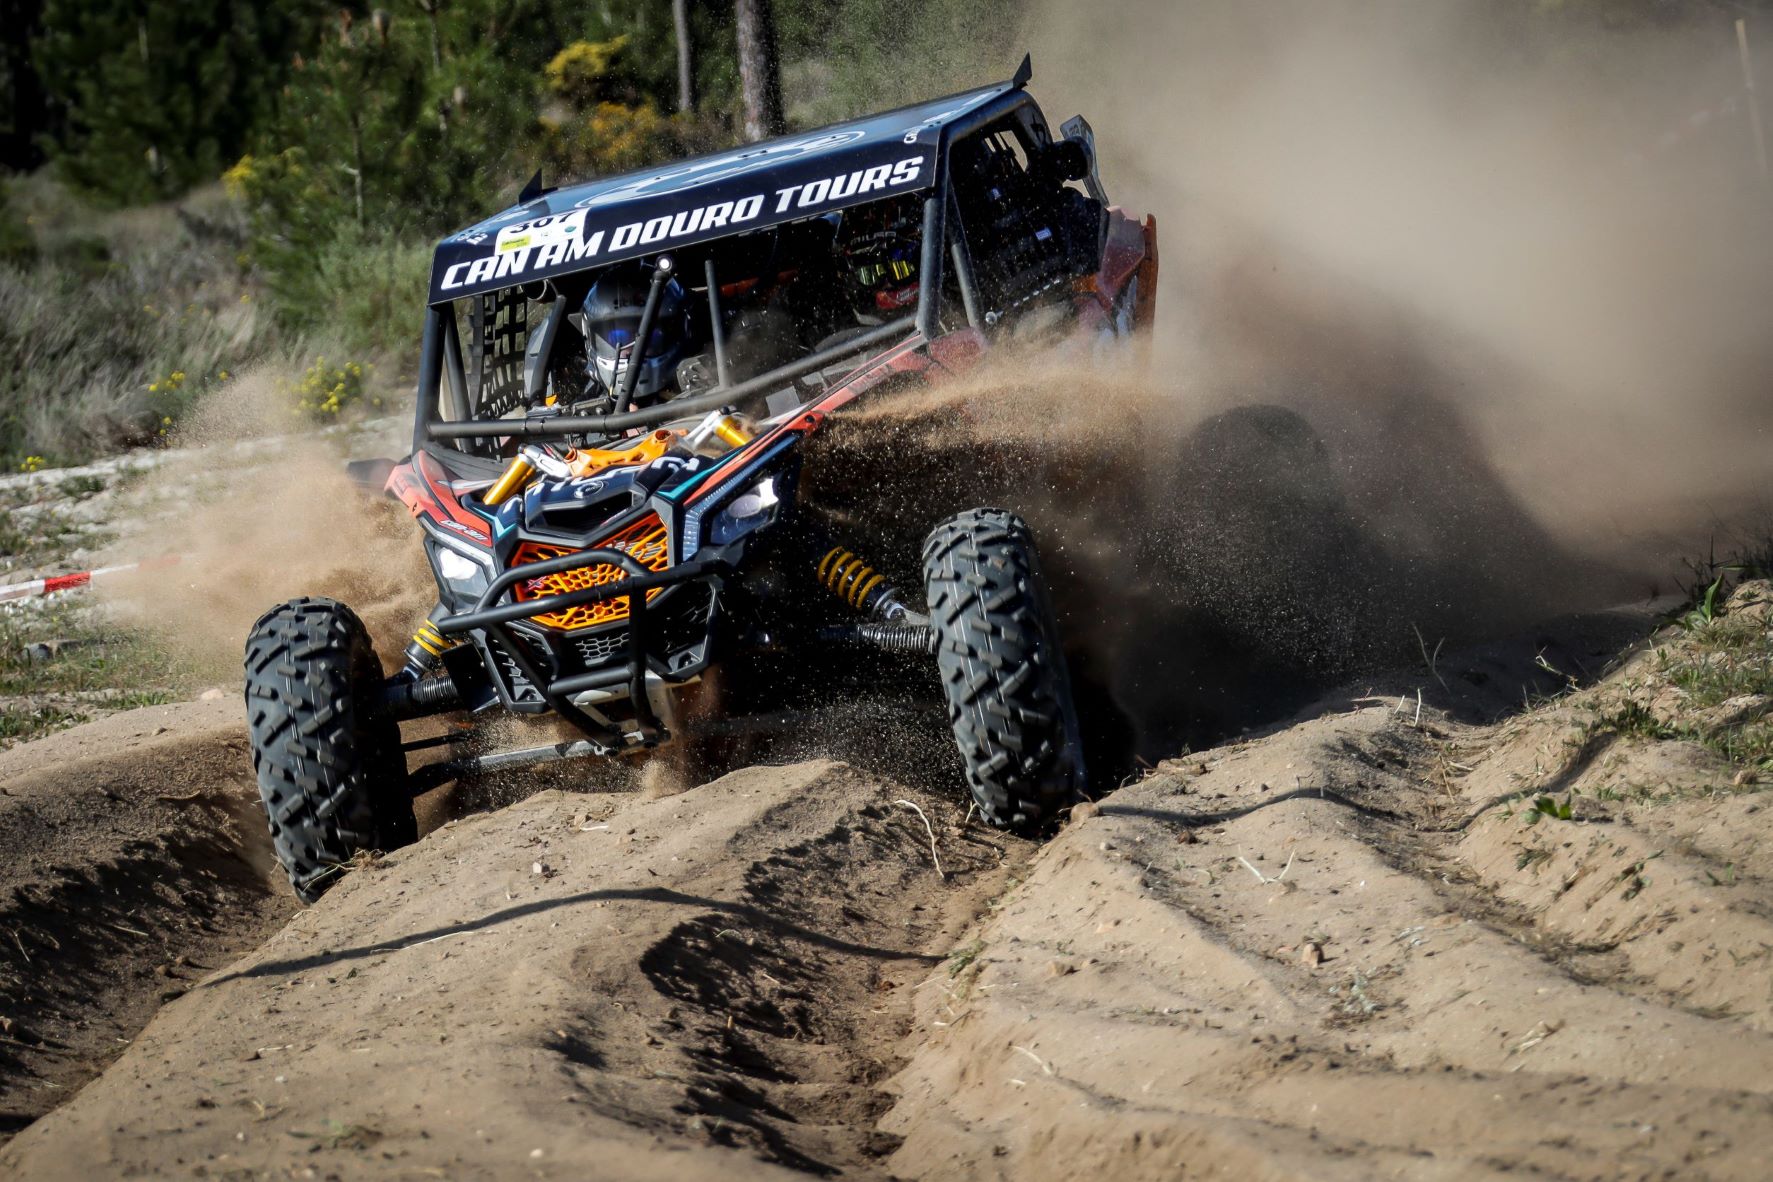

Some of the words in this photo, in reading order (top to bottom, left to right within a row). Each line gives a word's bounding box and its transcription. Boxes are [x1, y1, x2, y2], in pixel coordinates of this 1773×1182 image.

[440, 249, 531, 290] CAN
[533, 230, 605, 269] AM
[608, 195, 765, 252] DOURO
[775, 155, 924, 214] TOURS
[509, 211, 577, 234] 307
